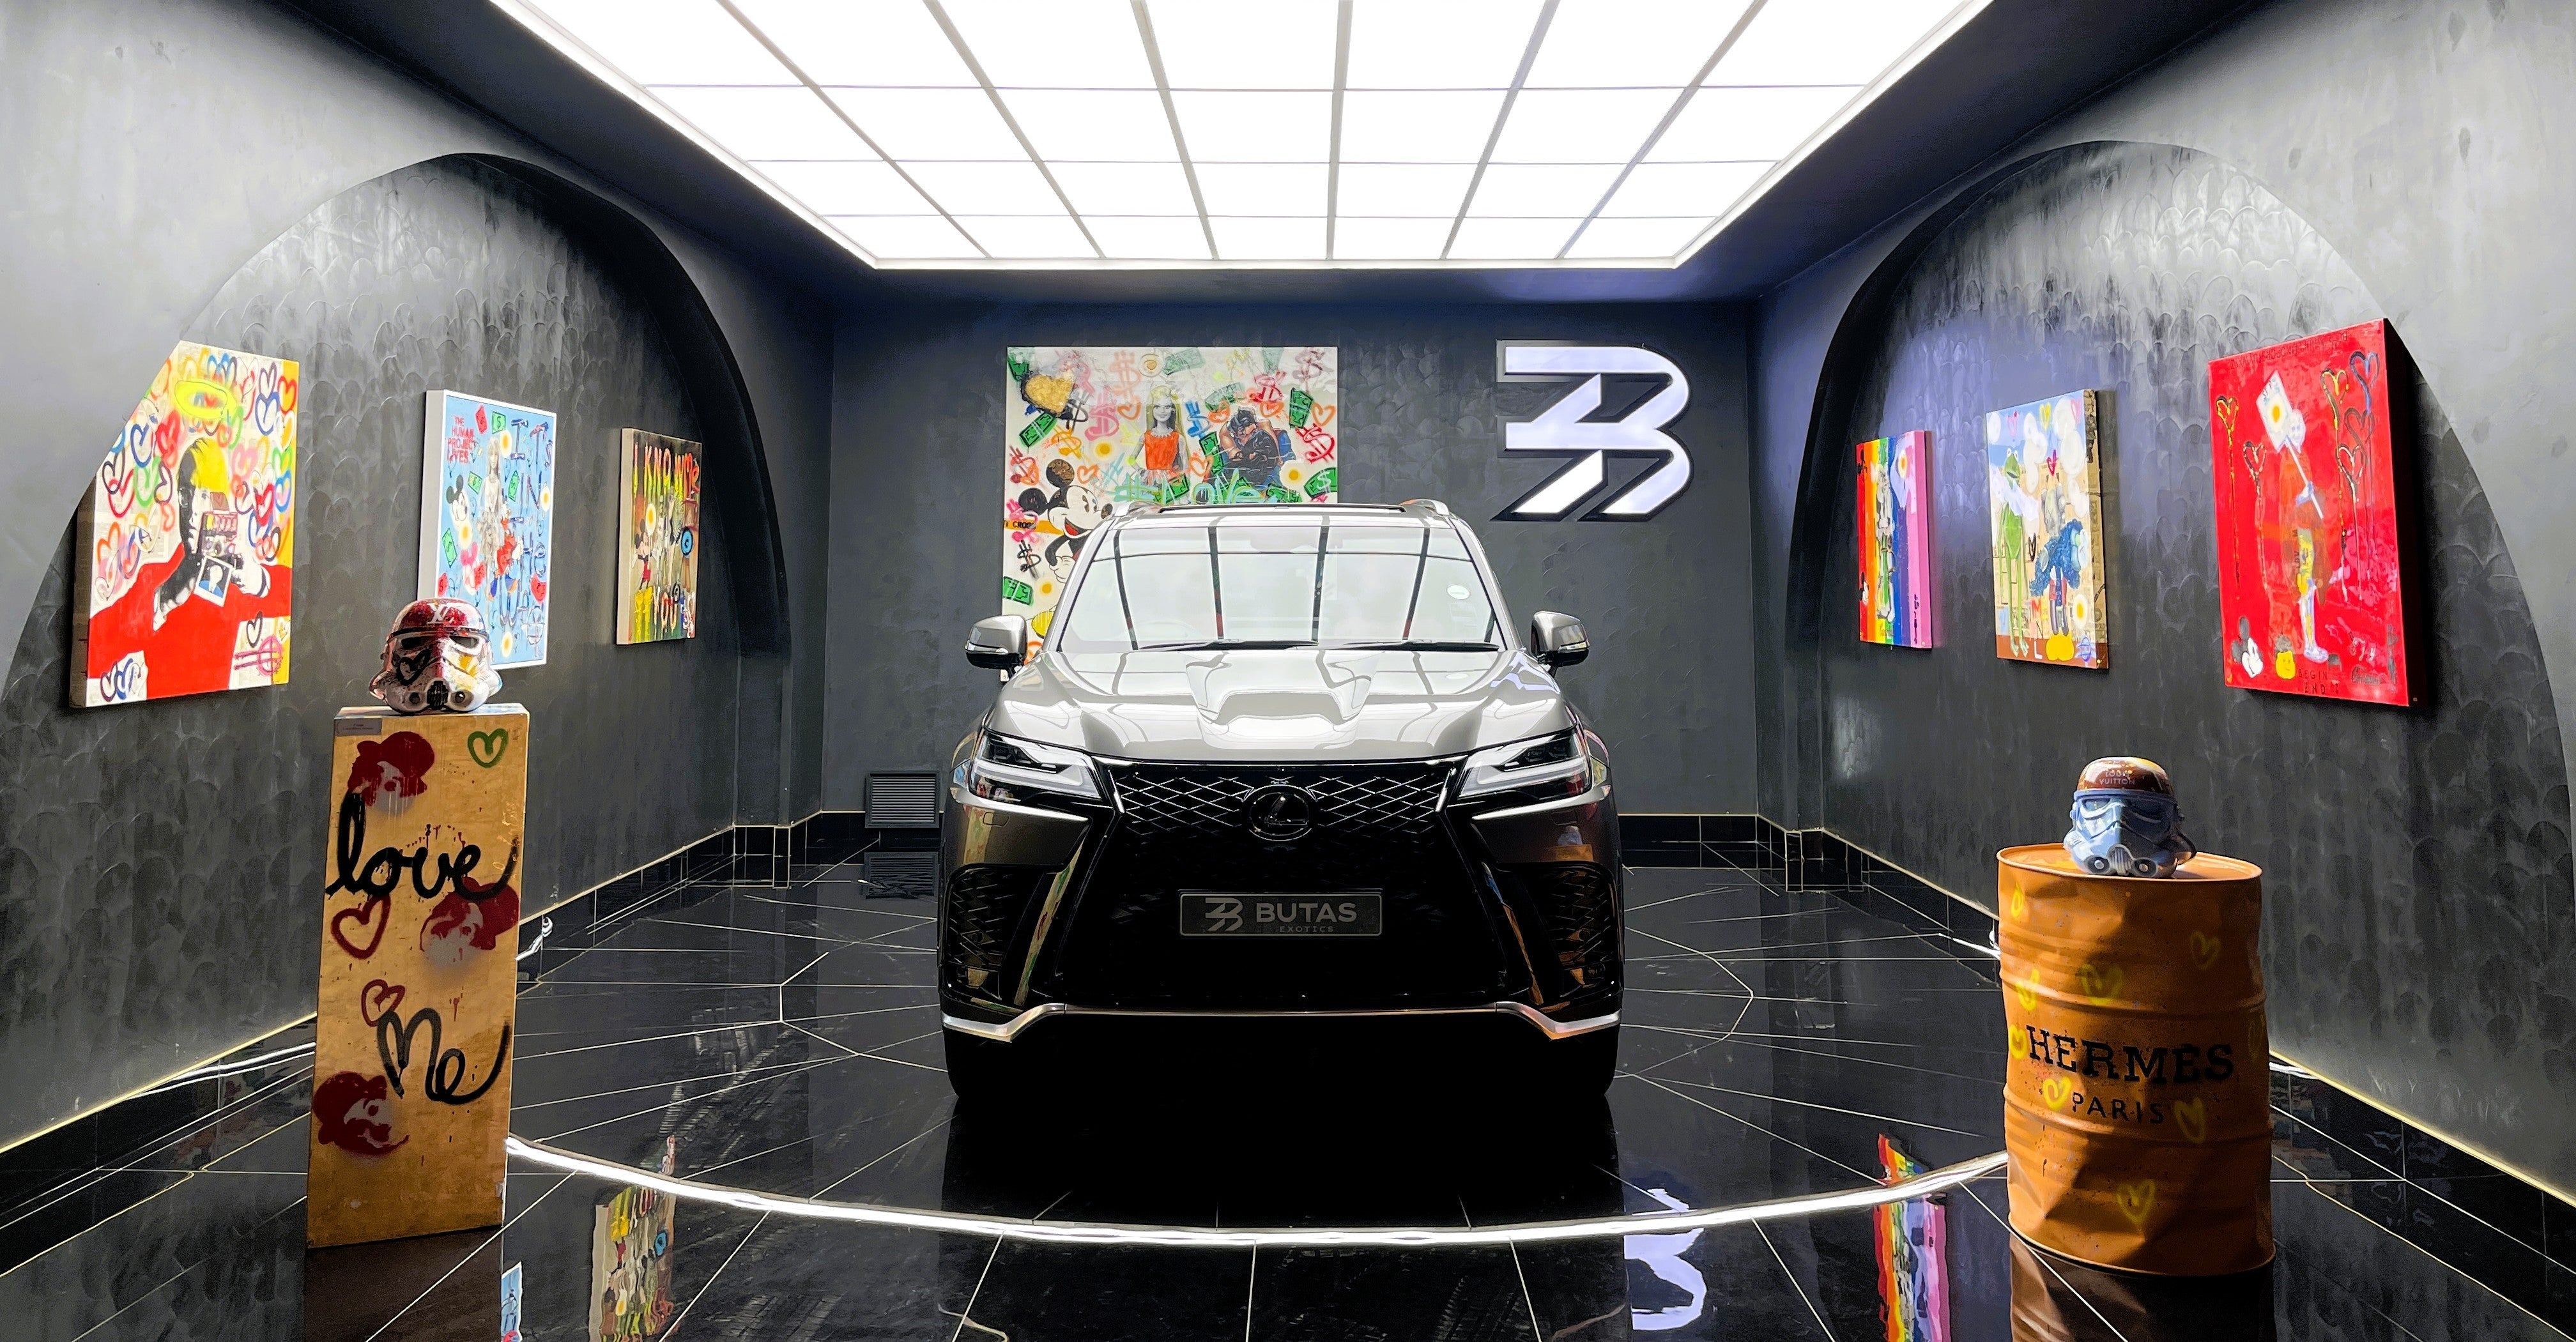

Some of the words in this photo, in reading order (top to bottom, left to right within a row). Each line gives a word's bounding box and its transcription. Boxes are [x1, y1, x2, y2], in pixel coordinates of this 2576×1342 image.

[2299, 668, 2327, 680] BEGIN
[325, 793, 518, 901] love
[1256, 903, 1357, 922] BUTAS
[2071, 1091, 2165, 1124] PARIS
